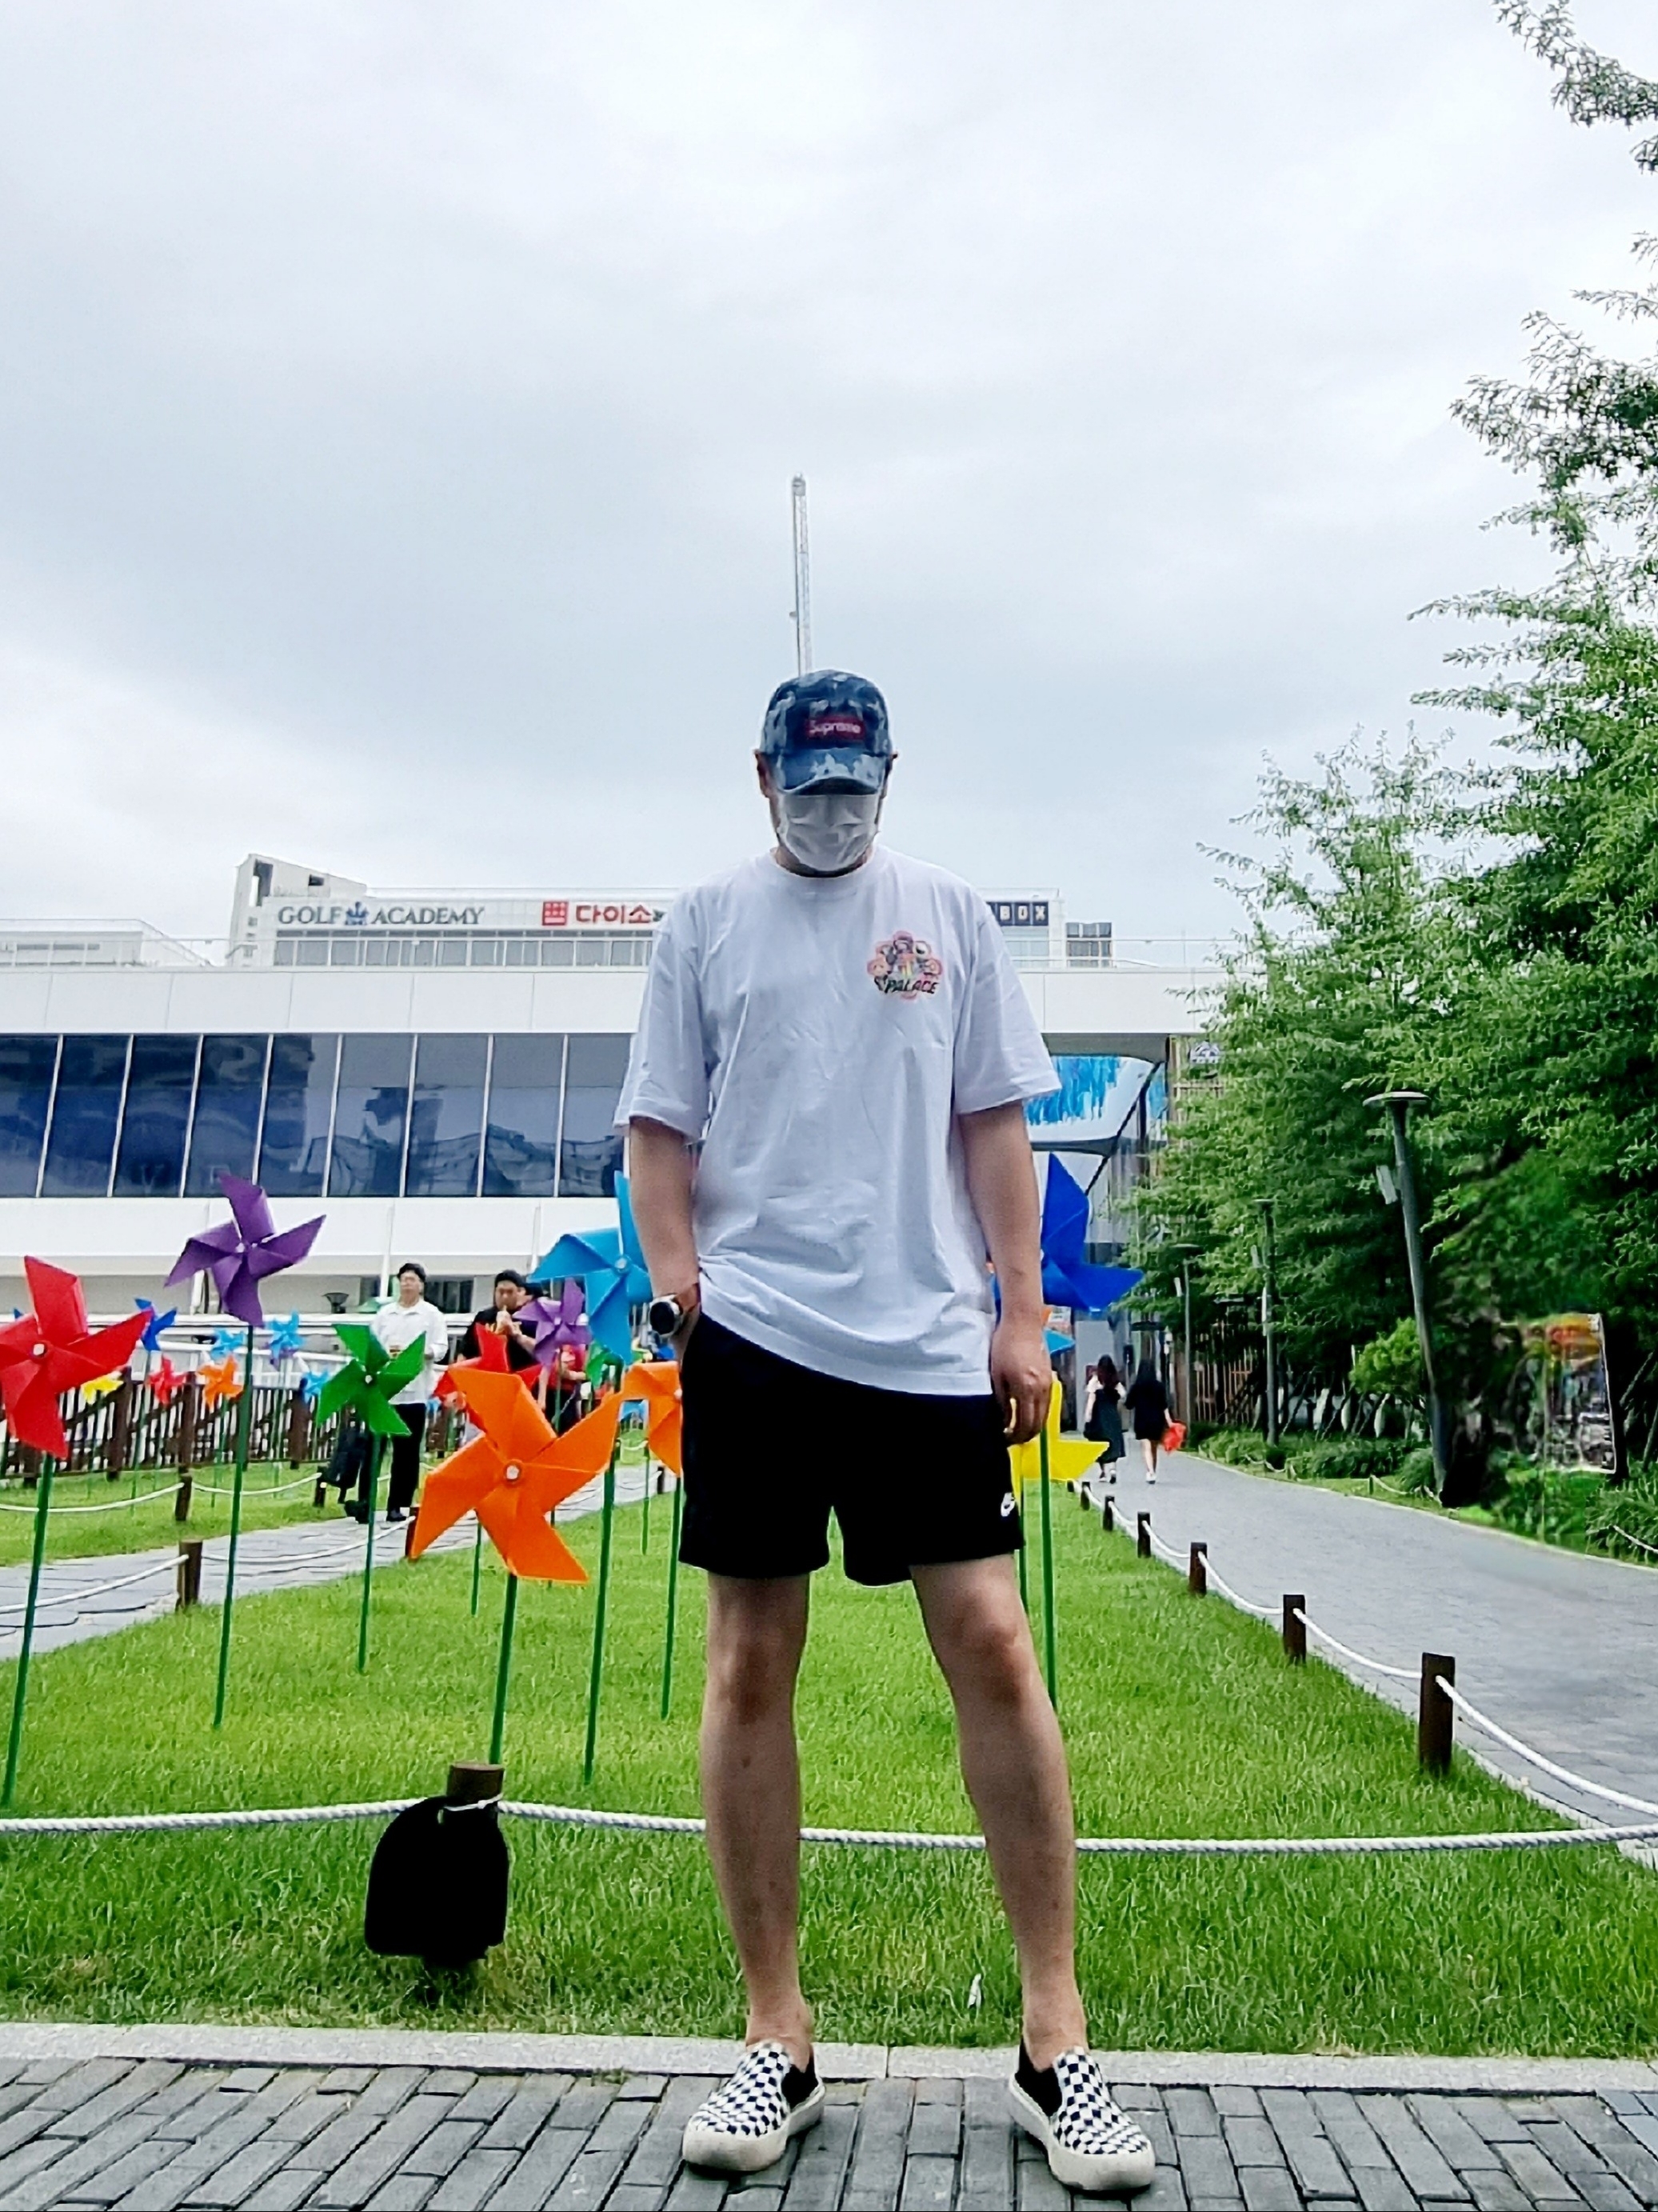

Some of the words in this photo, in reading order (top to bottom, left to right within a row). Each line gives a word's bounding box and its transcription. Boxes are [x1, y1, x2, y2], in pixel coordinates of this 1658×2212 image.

[278, 906, 342, 925] GOLF
[372, 906, 485, 925] ACADEMY
[575, 904, 651, 924] 다이소
